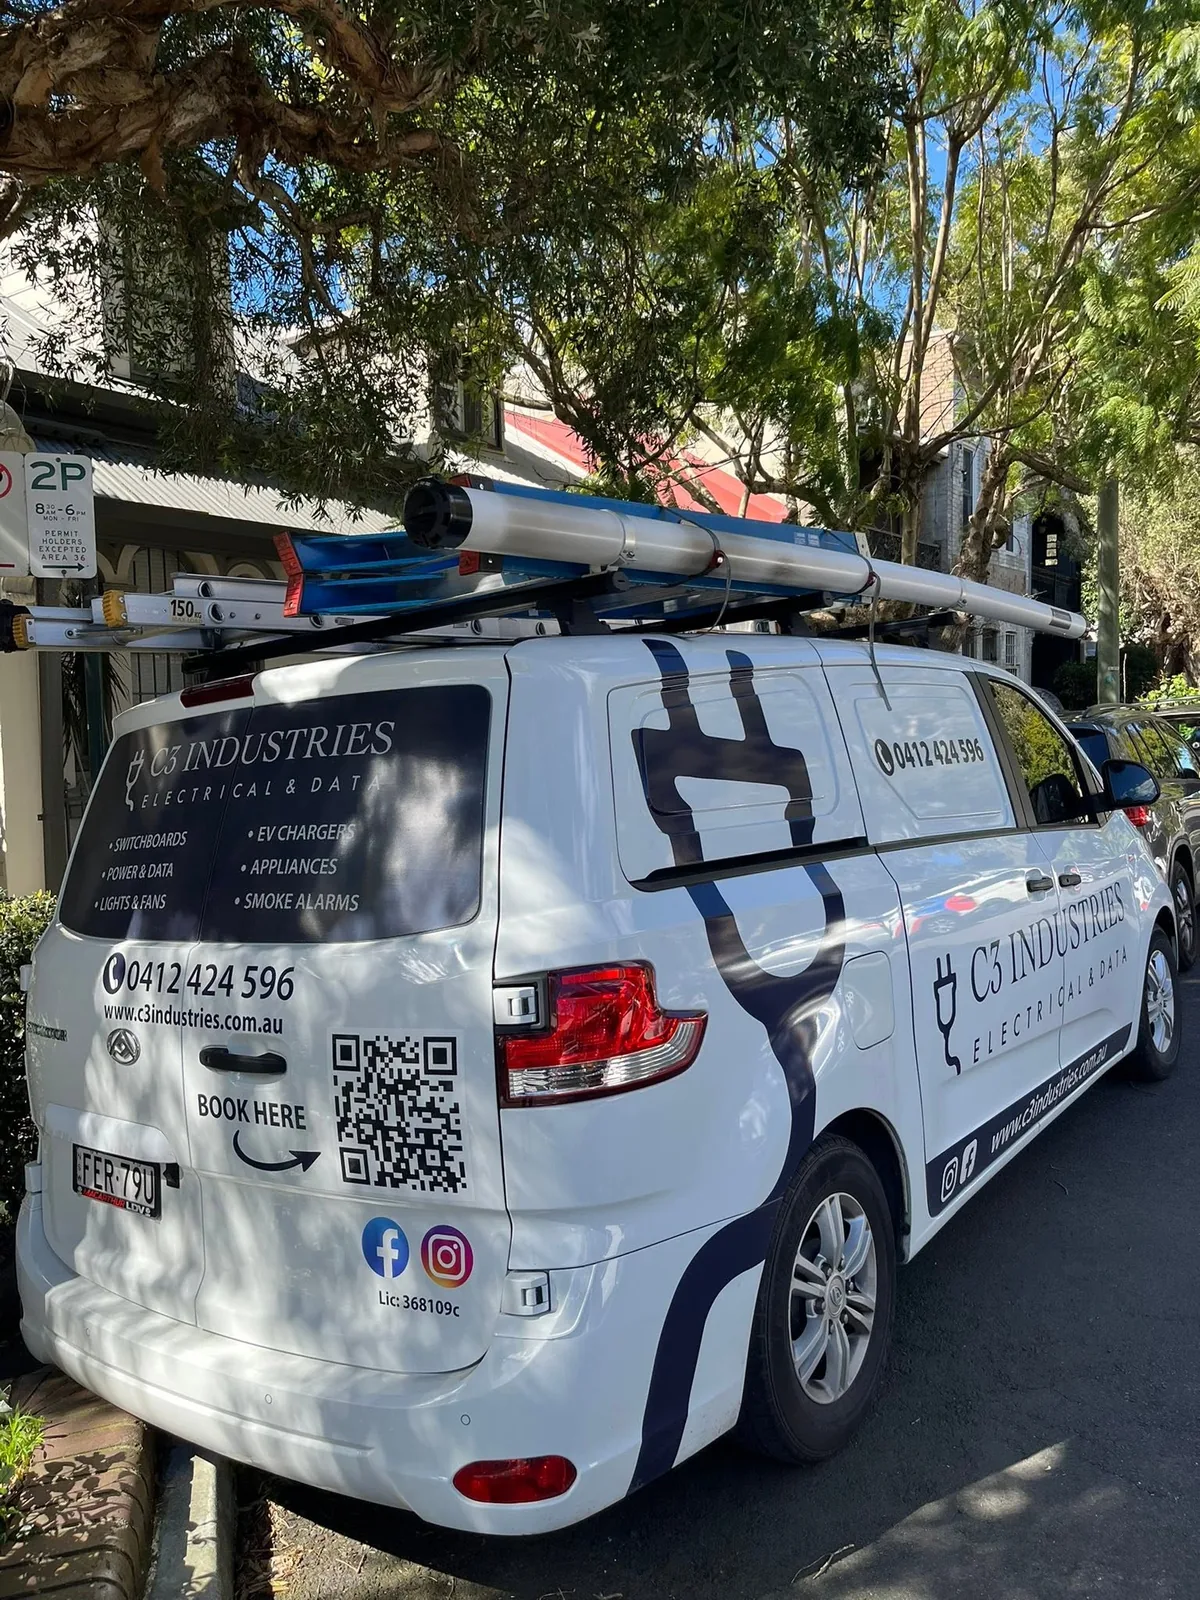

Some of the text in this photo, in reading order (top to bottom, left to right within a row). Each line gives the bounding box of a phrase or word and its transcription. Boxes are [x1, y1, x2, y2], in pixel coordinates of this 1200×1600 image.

[30, 461, 86, 491] 2P
[171, 599, 194, 617] 150
[150, 720, 396, 777] C3 INDUSTRIES
[893, 738, 984, 769] 0412 424 596
[141, 775, 381, 809] ELECTRICAL & DATA
[114, 830, 188, 852] SWITCHBOARDS
[257, 823, 356, 842] EV CHARGERS
[107, 863, 174, 880] POWER & DATA
[250, 858, 338, 876] APPLIANCES
[100, 894, 167, 911] LIGHTS & FANS
[244, 893, 360, 912] SMOKE ALARMS
[971, 881, 1126, 1003] C3 INDUSTRIES
[127, 960, 295, 1001] 0412 424 596
[104, 1003, 283, 1034] www.c3industries.com.au
[974, 944, 1128, 1064] ELECTRICAL & DATA
[197, 1093, 307, 1131] BOOK HERE
[990, 1044, 1108, 1154] www.c3industries.com.au
[126, 1201, 145, 1215] LDV
[379, 1291, 460, 1317] Lic: 368109c
